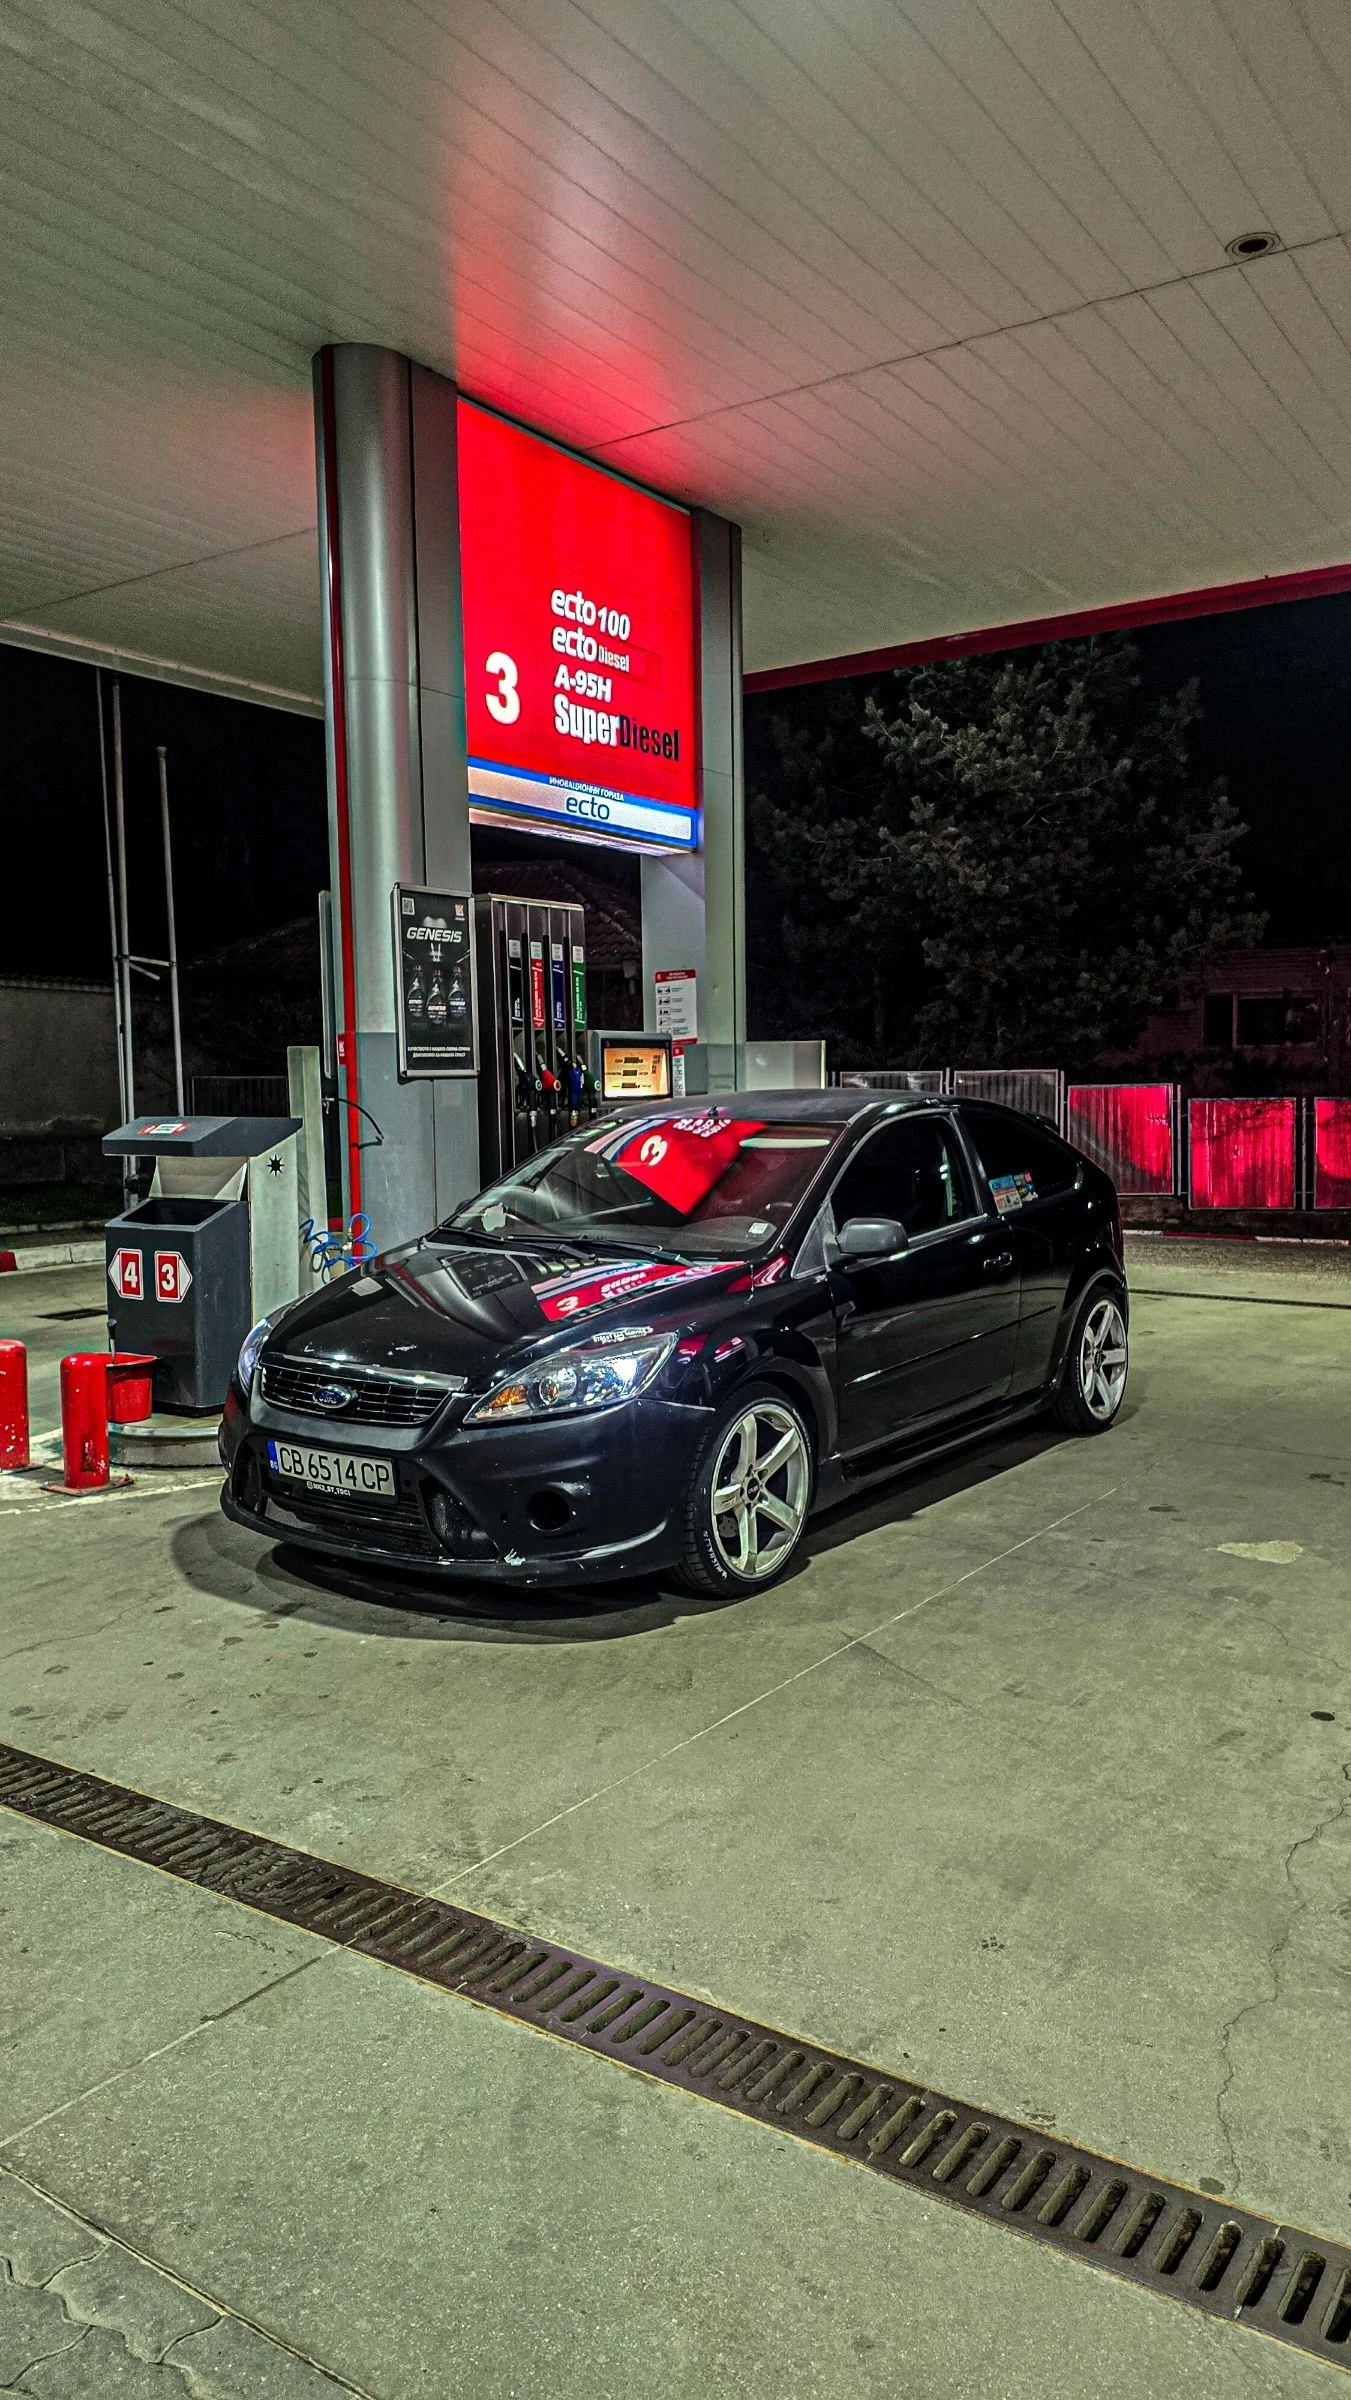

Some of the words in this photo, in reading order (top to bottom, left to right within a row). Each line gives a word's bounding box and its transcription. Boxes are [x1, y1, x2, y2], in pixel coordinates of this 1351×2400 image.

[551, 589, 596, 626] ecto
[598, 607, 630, 641] 100
[552, 626, 597, 662] ecto
[598, 645, 630, 673] Diesel
[485, 651, 520, 725] 3
[566, 796, 610, 820] ecto
[406, 926, 463, 943] GENESIS
[124, 1261, 138, 1288] 4
[161, 1263, 175, 1291] 3
[308, 1453, 357, 1487] 6514
